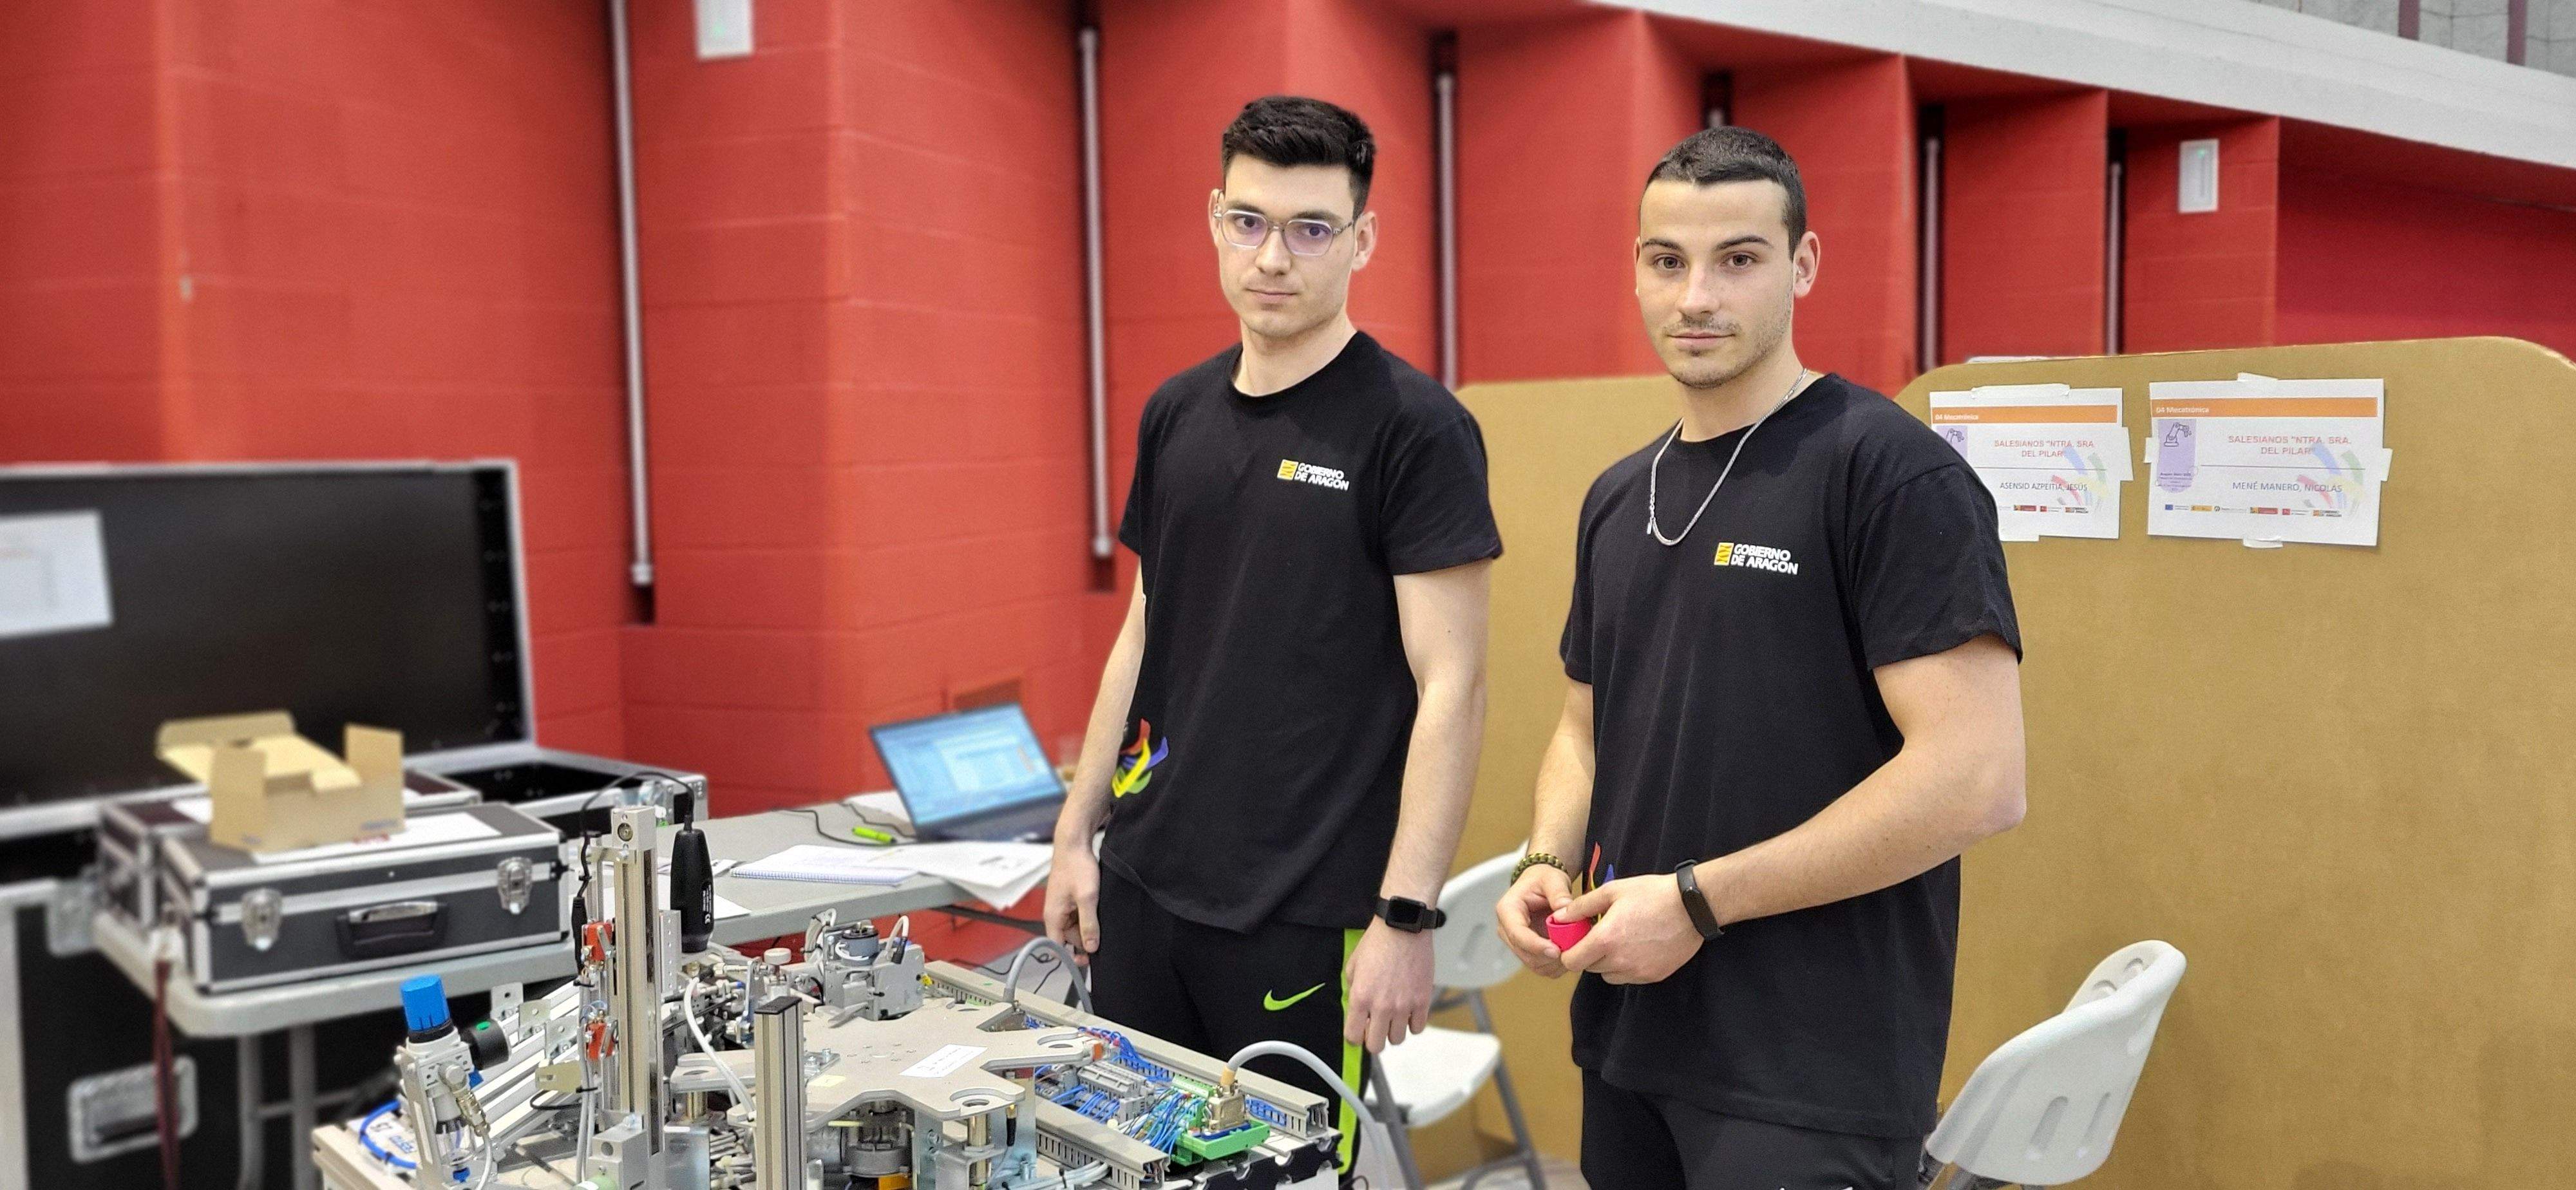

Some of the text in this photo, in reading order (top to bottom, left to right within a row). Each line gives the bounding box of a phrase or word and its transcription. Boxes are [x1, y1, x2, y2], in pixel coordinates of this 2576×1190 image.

[1294, 471, 1309, 482] DE
[1298, 462, 1344, 480] GOBIERNO
[2233, 480, 2258, 489] MENÉ
[2260, 483, 2302, 492] MANERO,
[1734, 543, 1791, 562] GOBIERNO
[1730, 554, 1745, 566] DE
